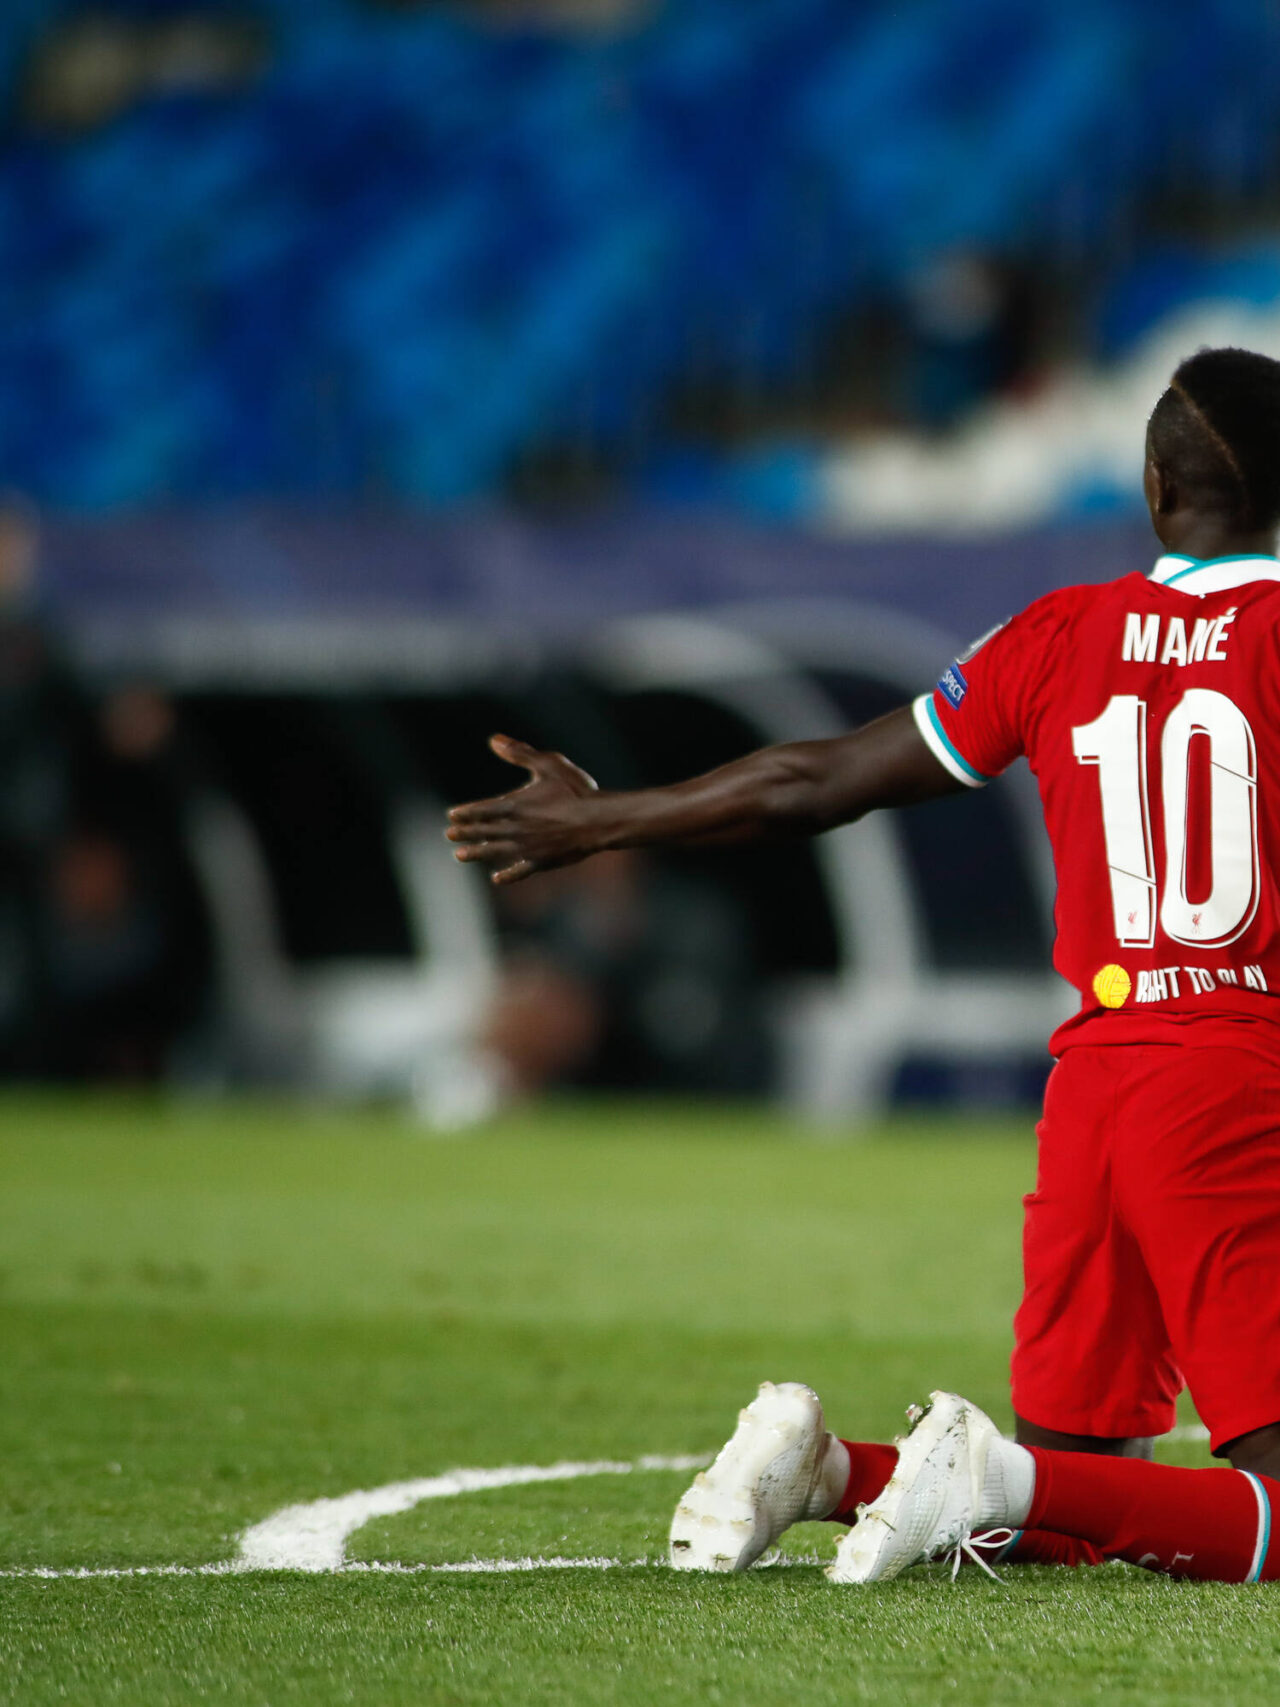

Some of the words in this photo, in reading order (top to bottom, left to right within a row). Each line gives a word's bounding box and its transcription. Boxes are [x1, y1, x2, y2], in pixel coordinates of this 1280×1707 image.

[1122, 606, 1238, 667] MANÉ
[1072, 688, 1261, 949] 10
[1184, 966, 1217, 995] TO
